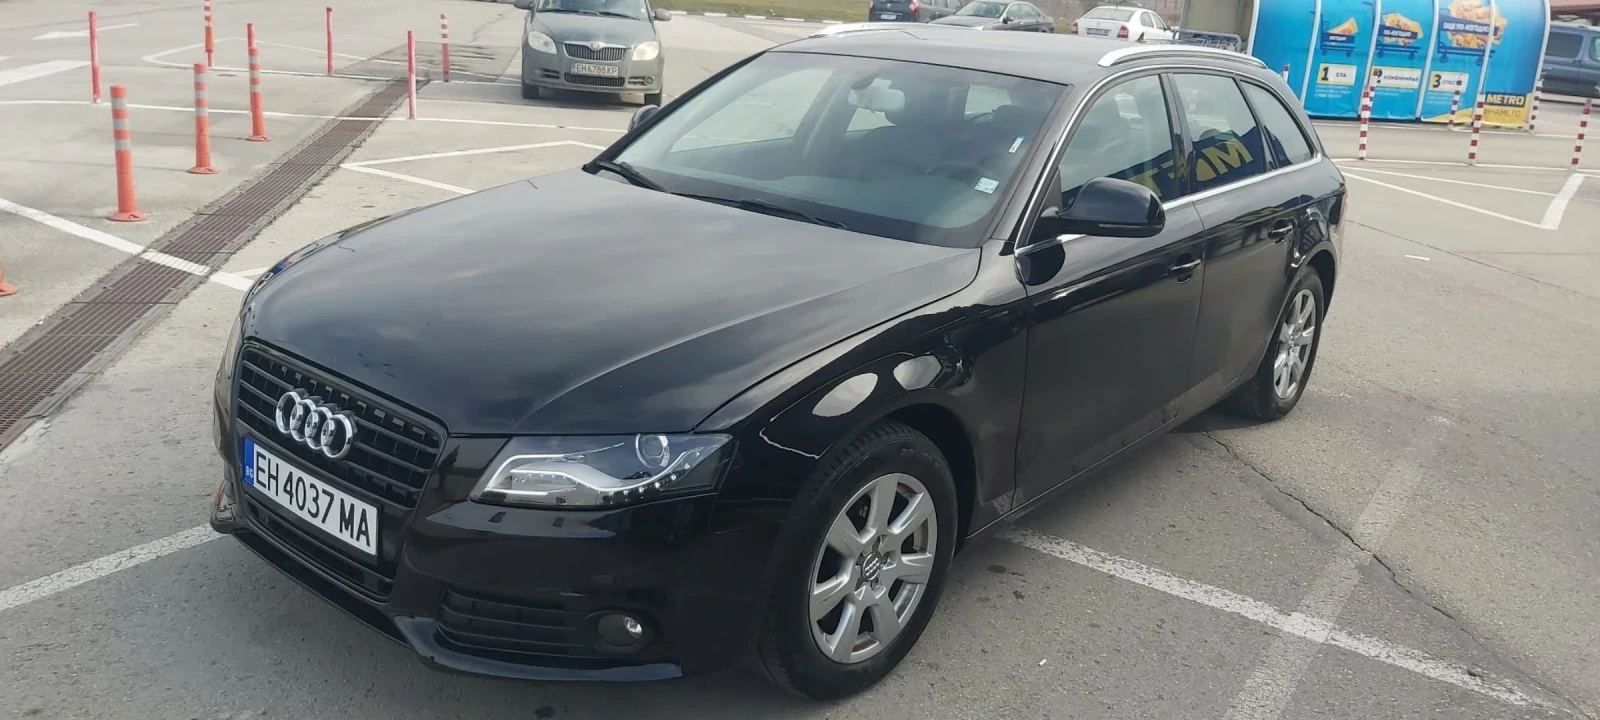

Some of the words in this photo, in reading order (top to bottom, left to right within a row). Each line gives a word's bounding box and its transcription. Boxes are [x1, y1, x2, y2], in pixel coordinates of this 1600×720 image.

[1321, 66, 1329, 81] 1
[1432, 74, 1442, 88] 3
[1486, 94, 1525, 106] METRO
[256, 450, 279, 497] EH
[283, 470, 335, 525] 4037
[339, 498, 371, 548] MA
